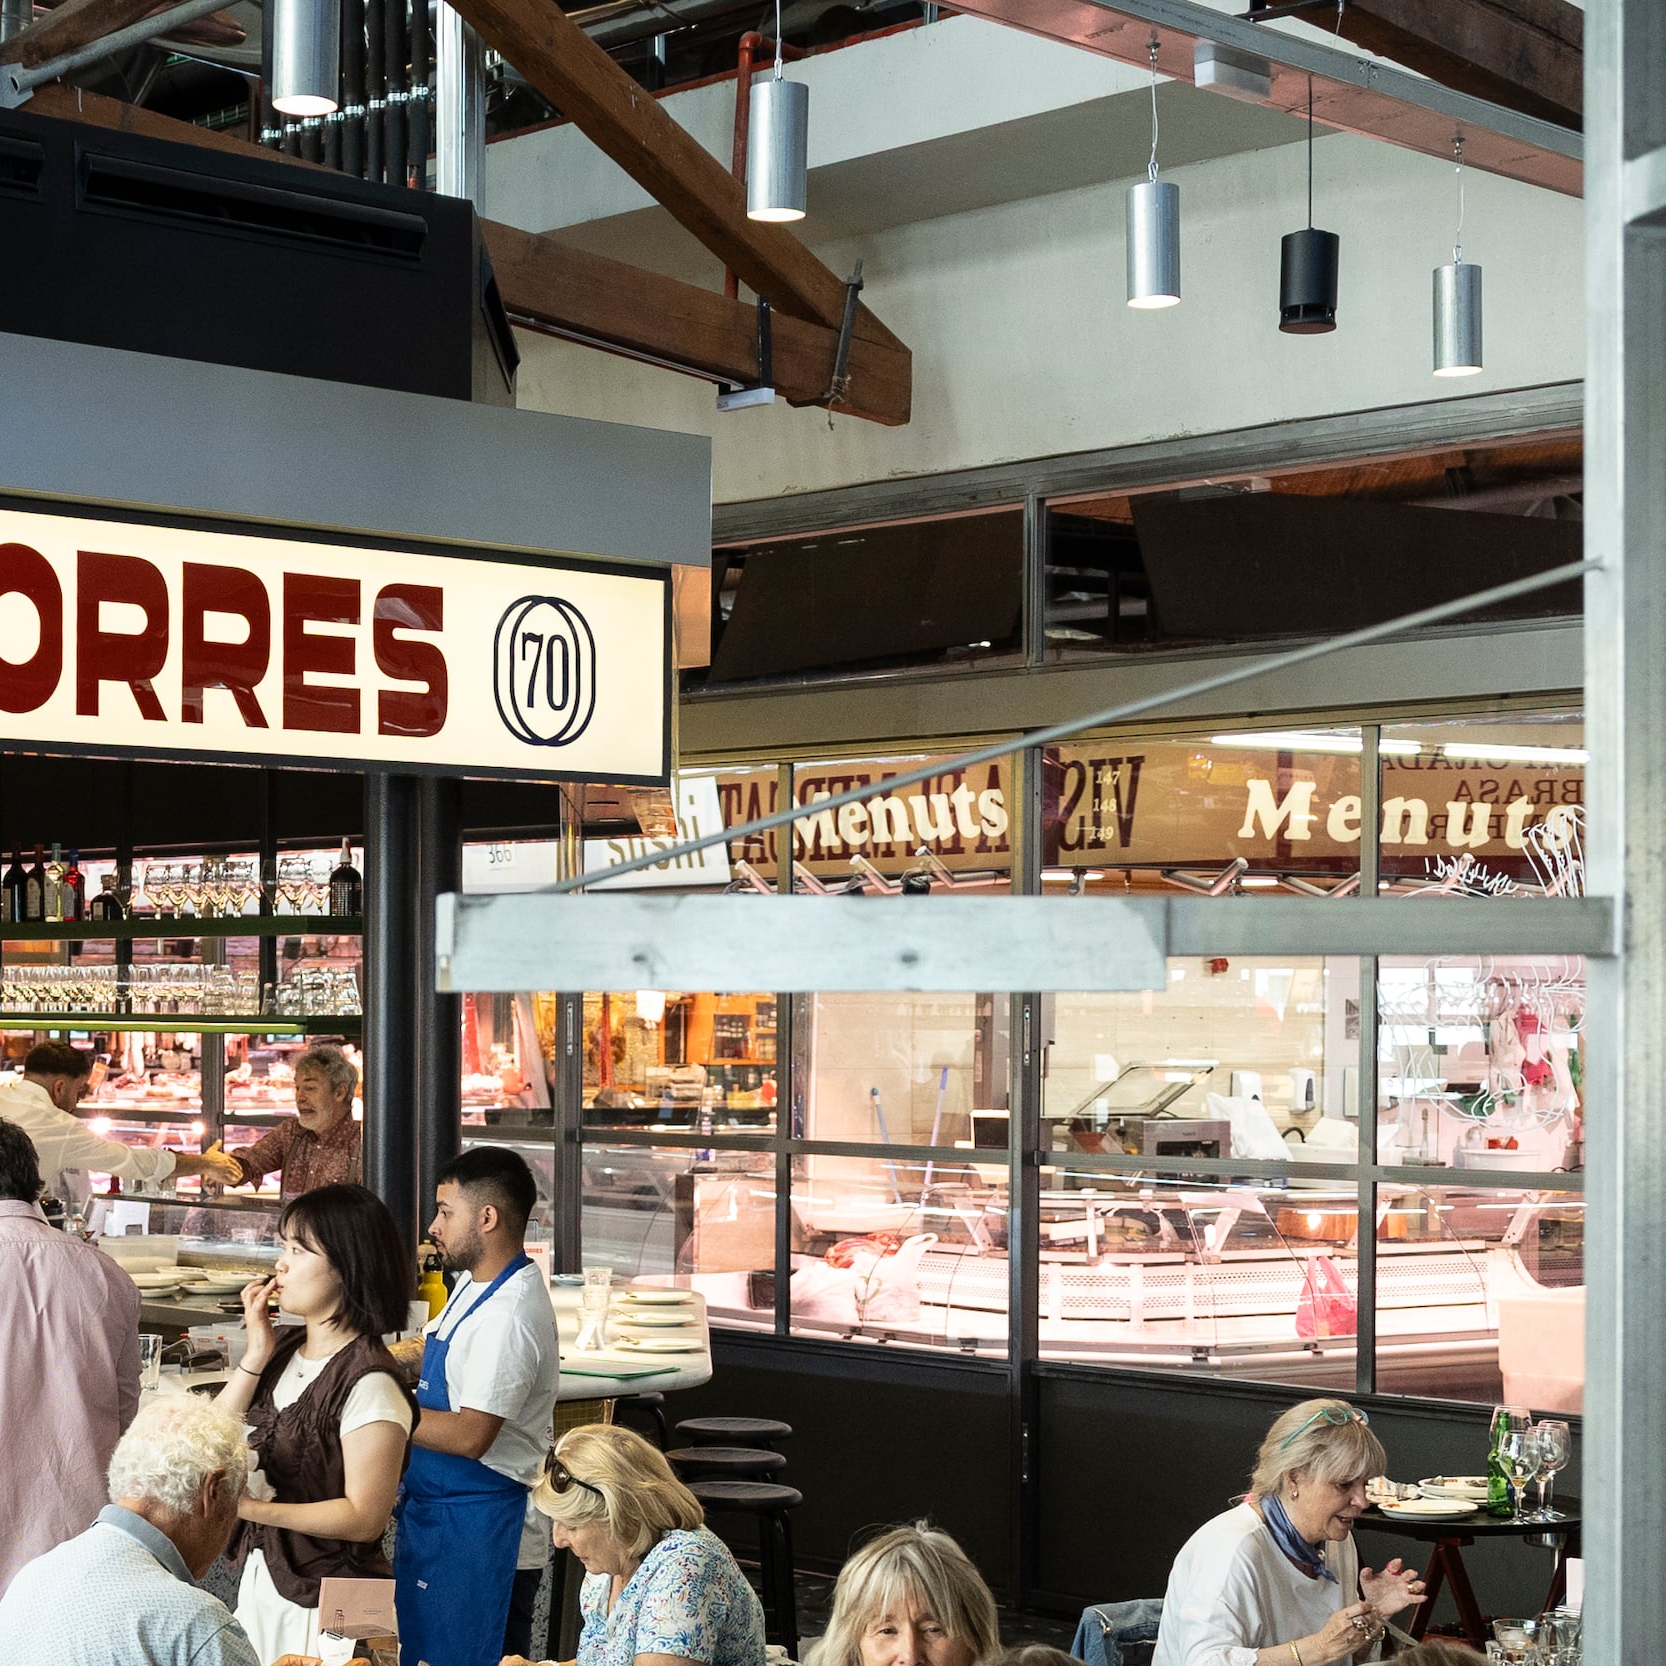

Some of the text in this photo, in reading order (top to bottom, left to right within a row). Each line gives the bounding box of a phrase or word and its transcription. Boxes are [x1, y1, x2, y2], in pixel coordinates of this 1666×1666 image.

[520, 631, 571, 714] 70
[1095, 770, 1121, 785] 147
[1092, 798, 1118, 813] 148
[792, 782, 1008, 849] Menuts
[1089, 826, 1115, 840] 149
